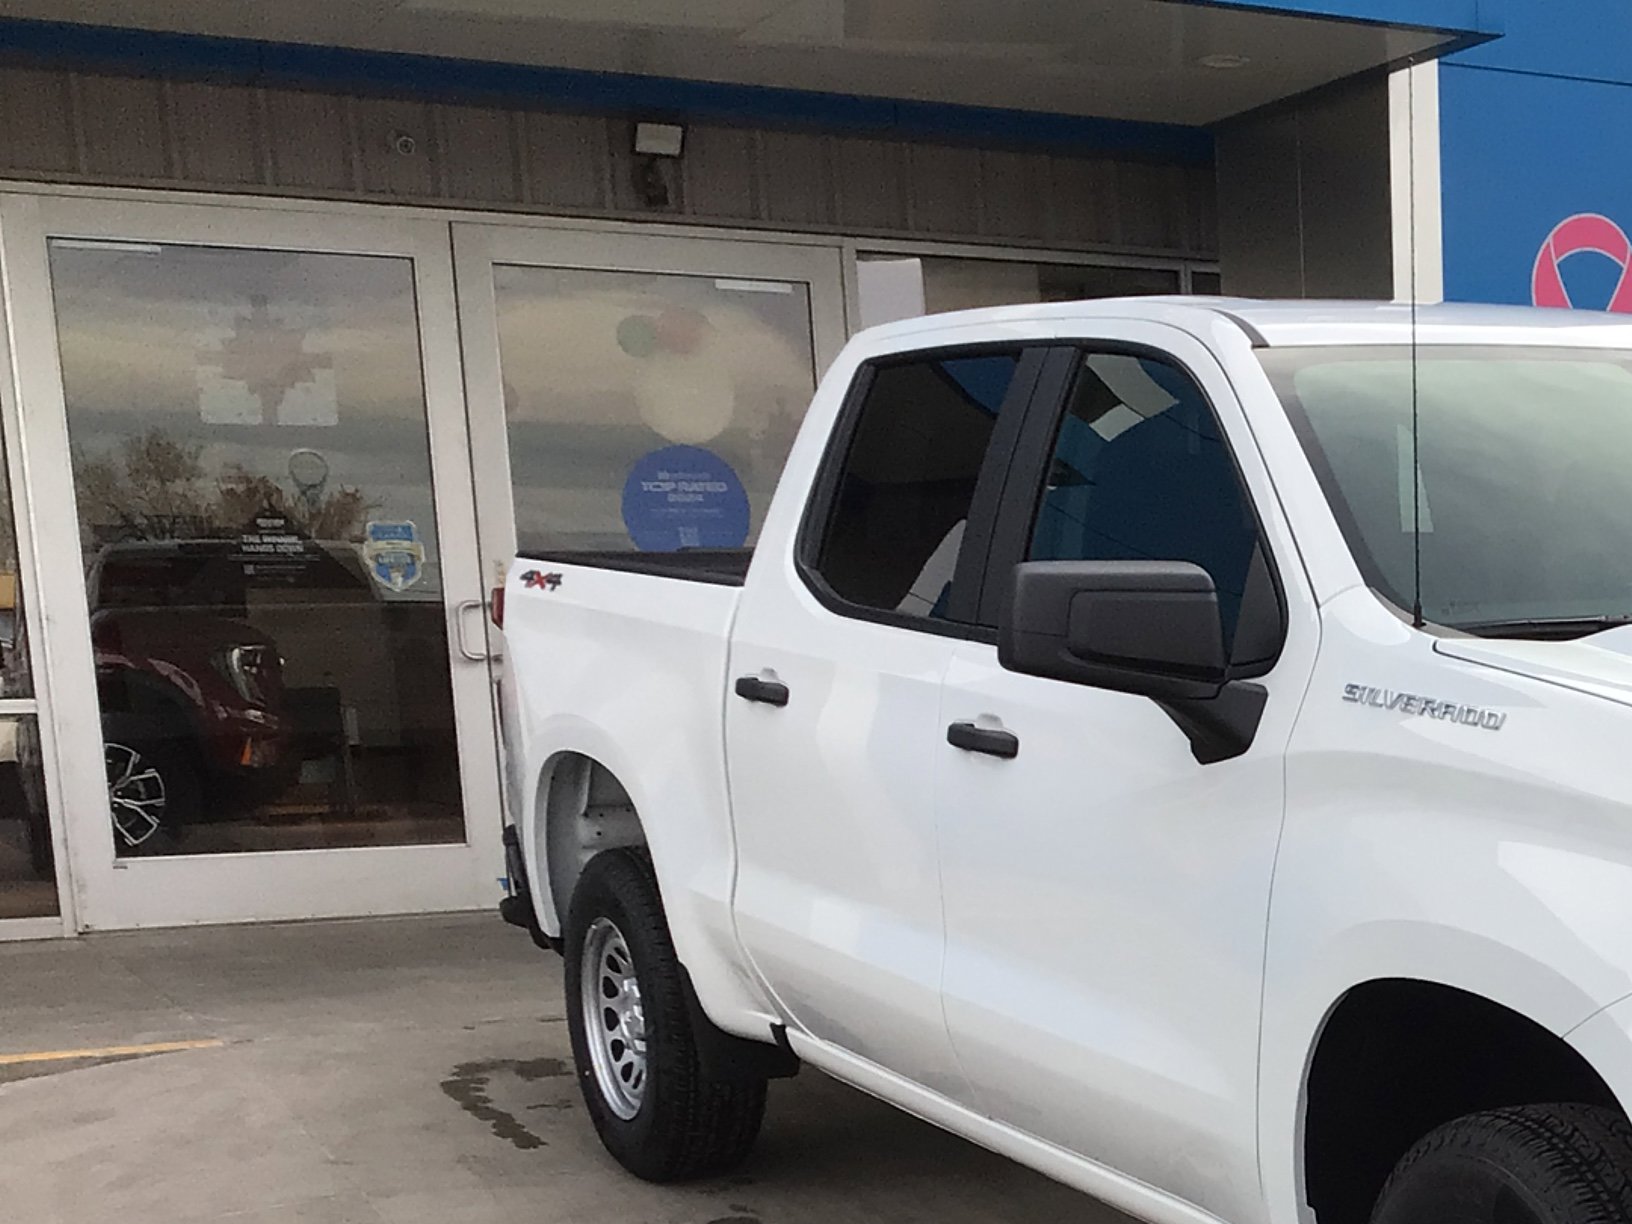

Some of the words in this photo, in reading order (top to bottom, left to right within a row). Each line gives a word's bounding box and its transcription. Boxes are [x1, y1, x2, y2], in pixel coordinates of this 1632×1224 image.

[640, 481, 676, 492] TOP
[677, 481, 728, 492] RATED
[1341, 683, 1507, 731] SILVERADO
